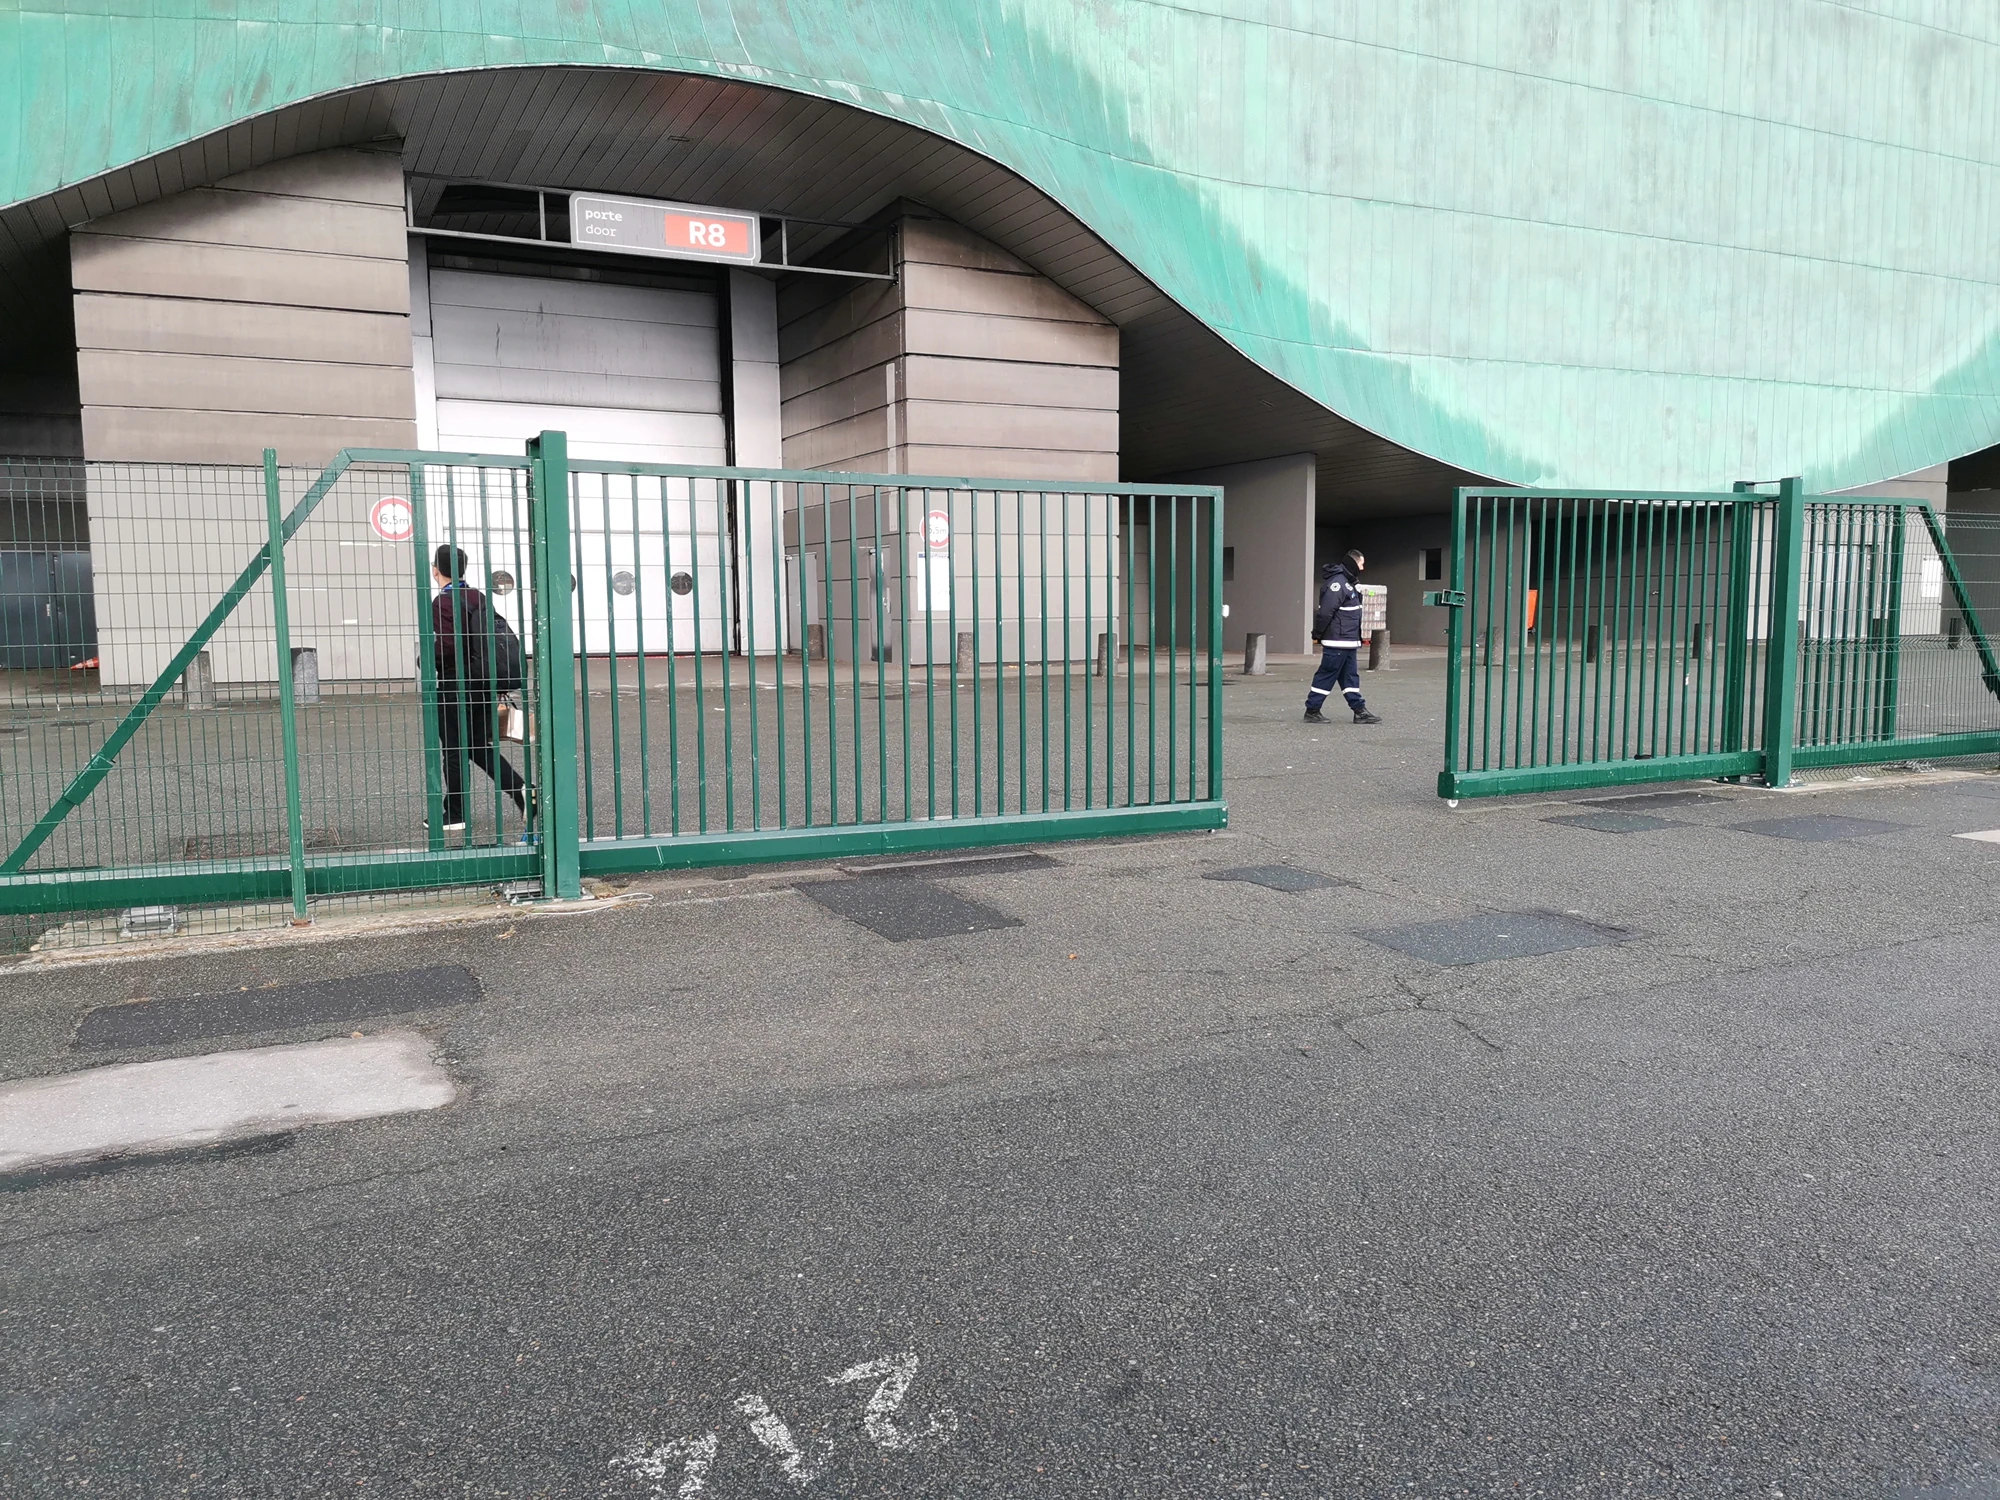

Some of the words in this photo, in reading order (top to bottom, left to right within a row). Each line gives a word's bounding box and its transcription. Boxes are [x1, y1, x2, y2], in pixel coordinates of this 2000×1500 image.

[585, 209, 623, 222] porte
[585, 224, 617, 237] door
[689, 220, 726, 248] R8
